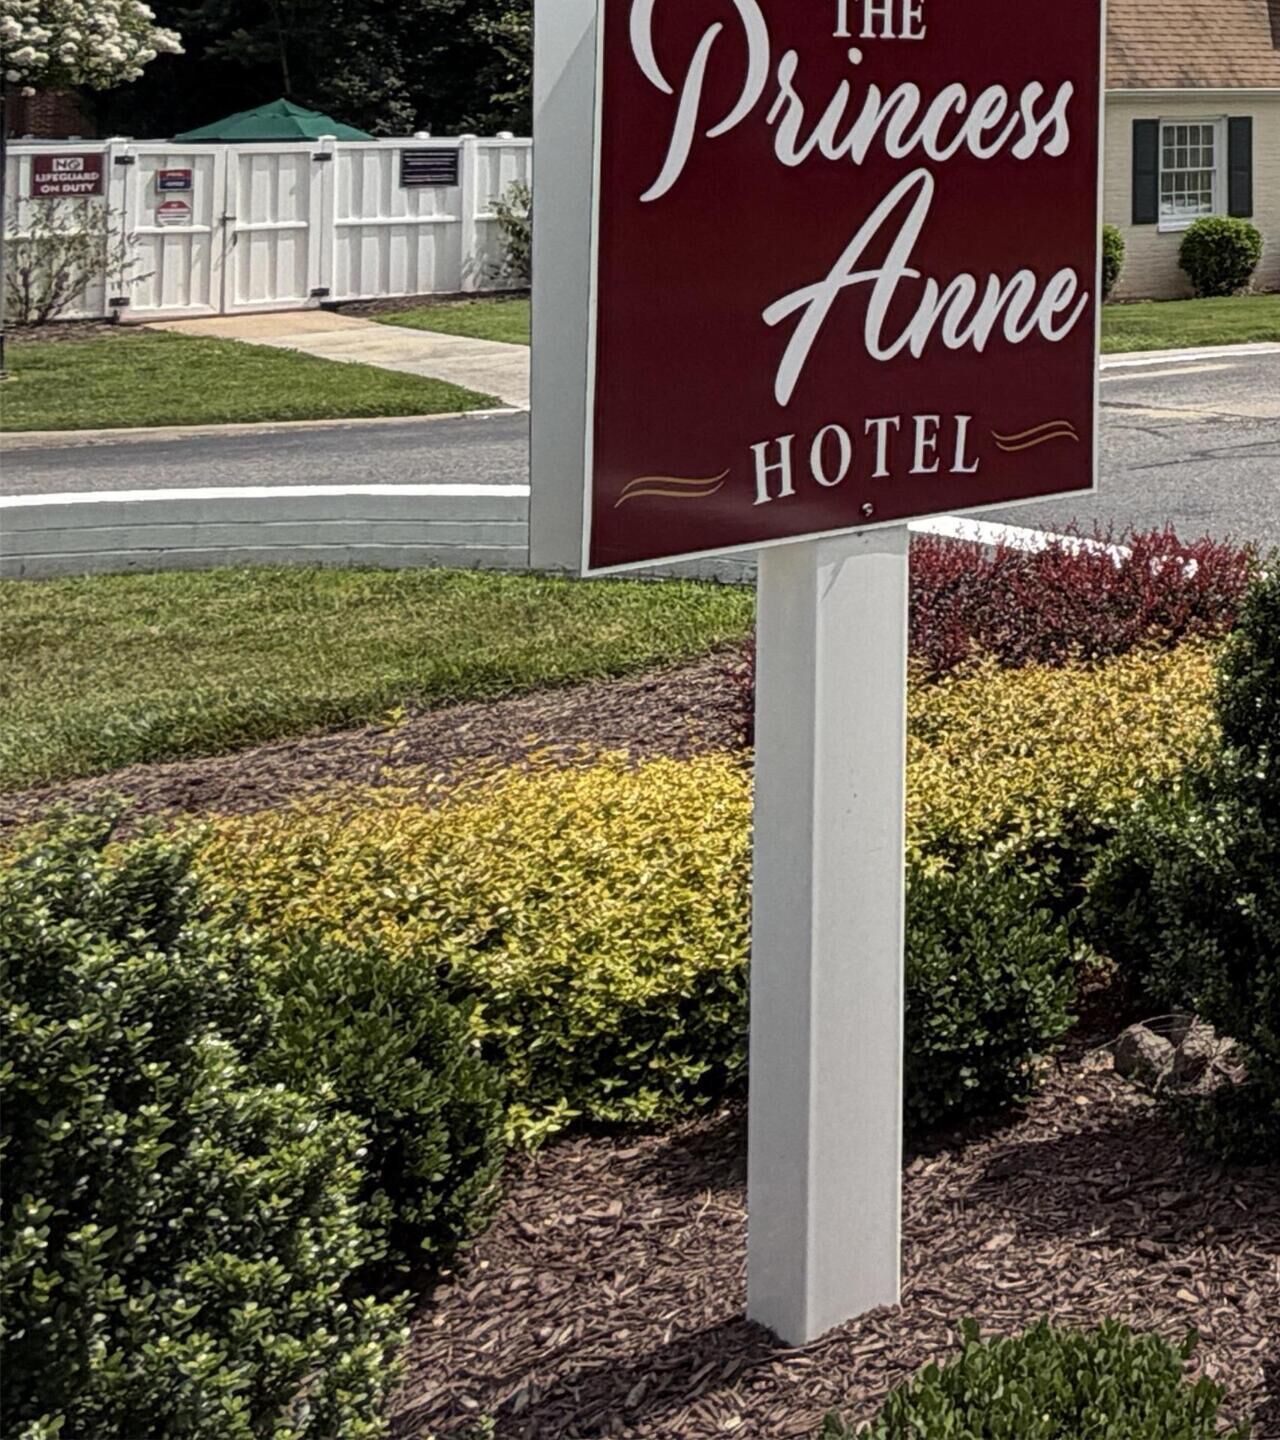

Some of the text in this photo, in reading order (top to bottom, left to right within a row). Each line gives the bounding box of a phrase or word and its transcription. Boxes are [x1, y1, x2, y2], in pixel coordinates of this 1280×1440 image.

[56, 159, 80, 170] NO
[35, 171, 100, 182] LIFEGUARD
[40, 182, 95, 193] ON DUTY
[761, 167, 1089, 407] Anne
[749, 414, 981, 507] HOTEL
